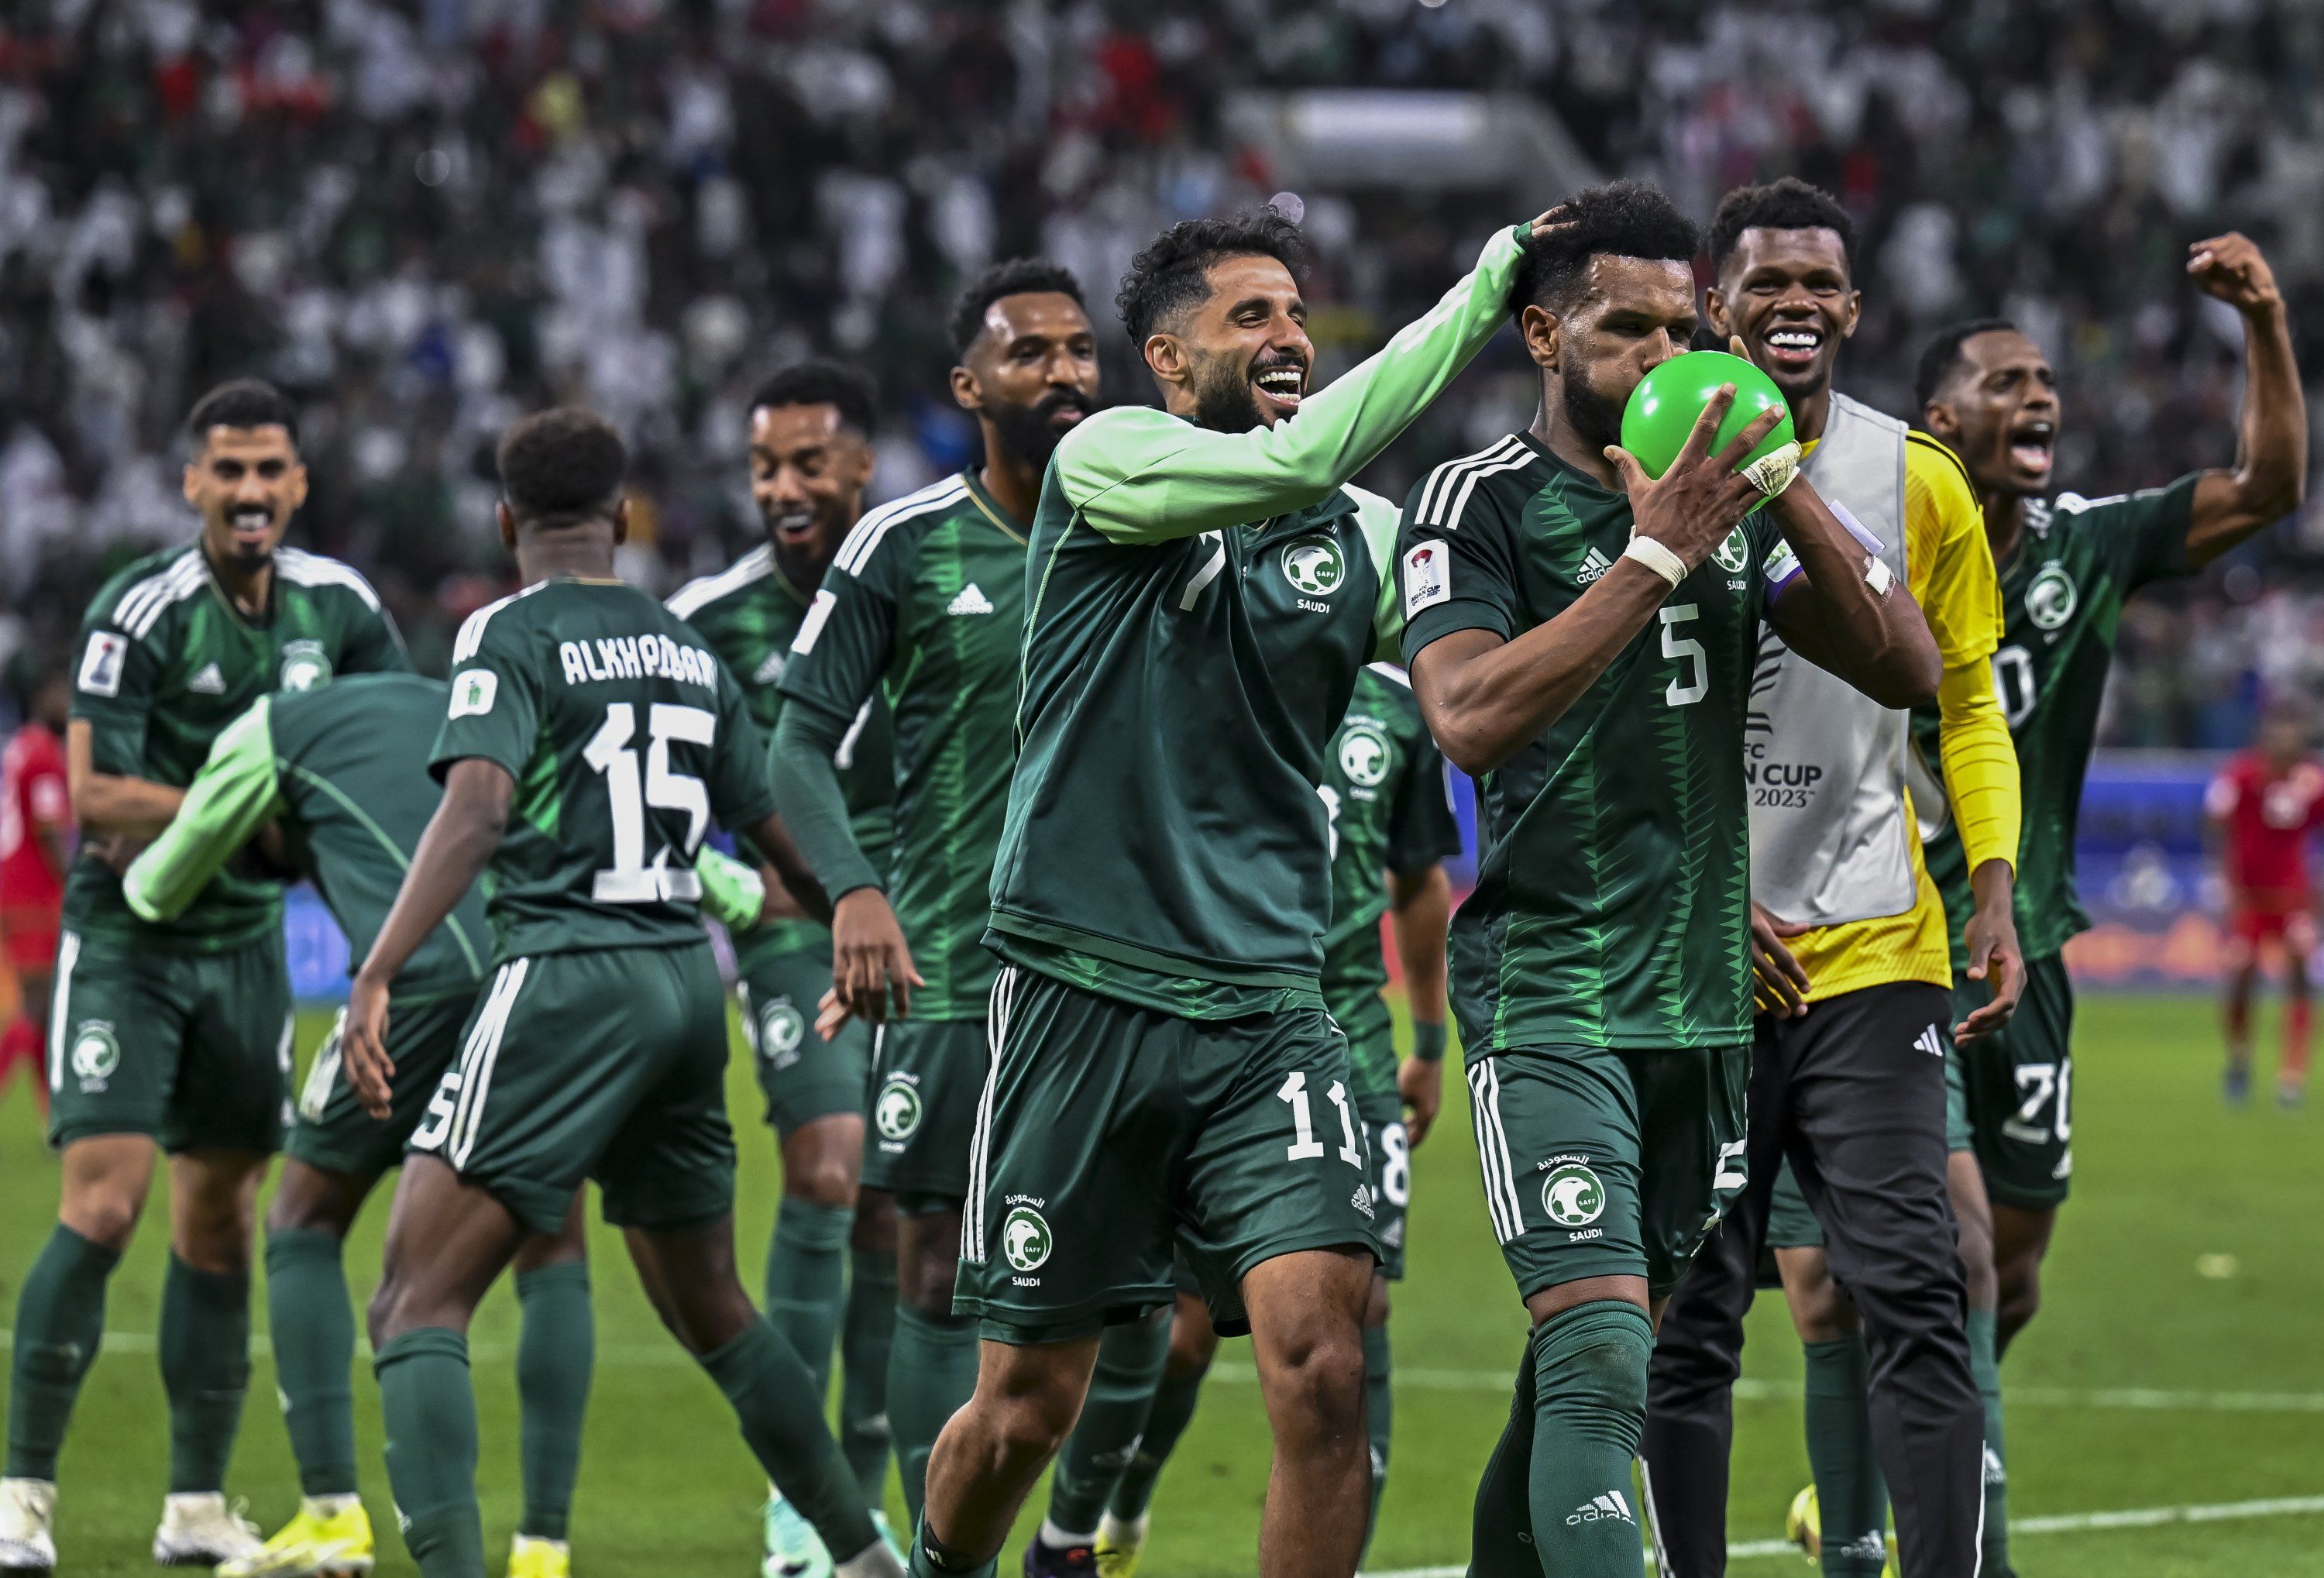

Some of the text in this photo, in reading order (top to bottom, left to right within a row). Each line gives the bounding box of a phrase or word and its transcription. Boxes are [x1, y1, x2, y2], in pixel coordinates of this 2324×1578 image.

[1727, 580, 1746, 590] SAUDI
[1411, 585, 1441, 603] ASIAN CUP
[1297, 599, 1330, 614] SAUDI
[1659, 603, 1709, 706] 5
[1762, 763, 1822, 787] CUP
[583, 702, 717, 904] 15
[1277, 1071, 1362, 1171] 11
[1537, 1154, 1590, 1171] السعودية
[1005, 1194, 1046, 1208] السعودية
[1351, 1198, 1375, 1220] adidas
[1569, 1228, 1603, 1242] SAUDI
[1012, 1276, 1040, 1287] SAUDI
